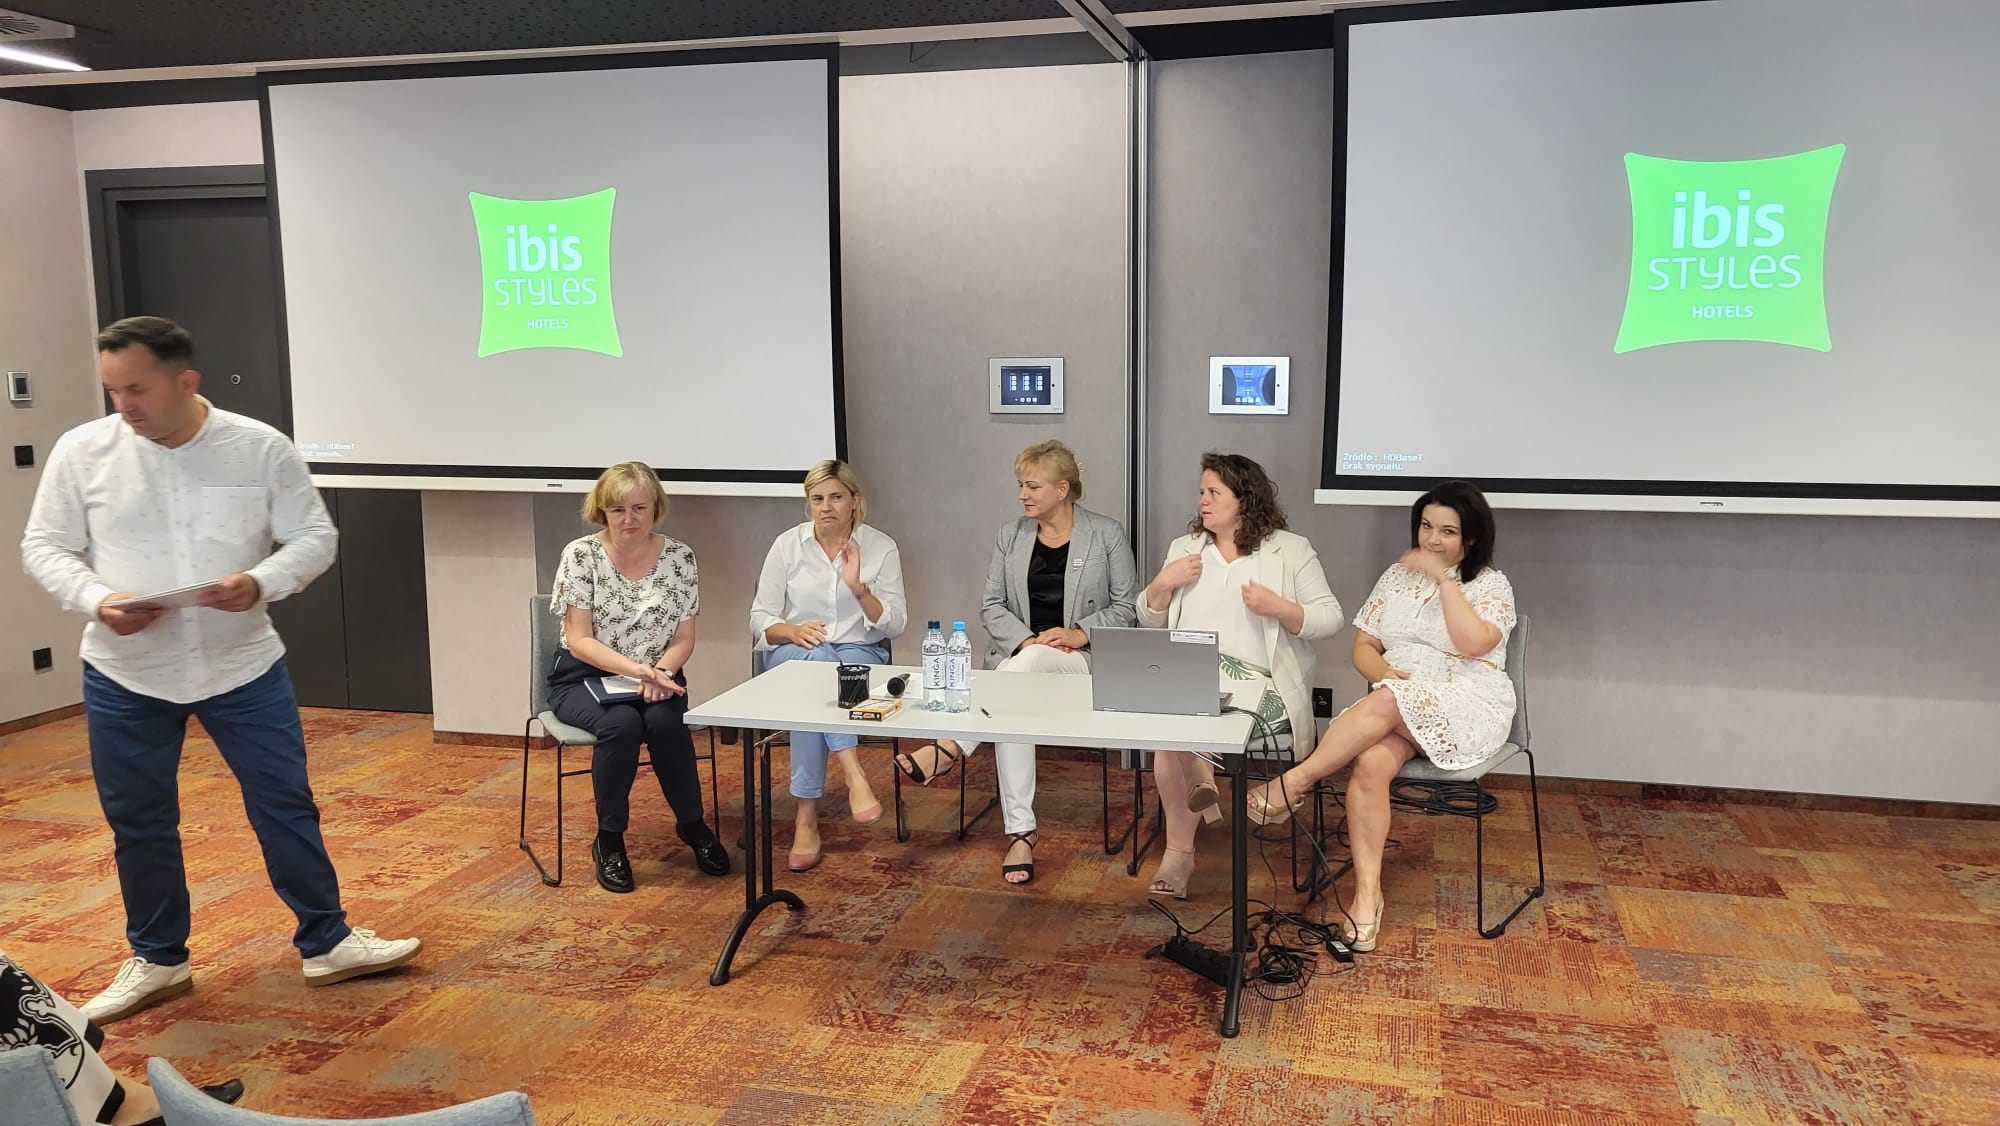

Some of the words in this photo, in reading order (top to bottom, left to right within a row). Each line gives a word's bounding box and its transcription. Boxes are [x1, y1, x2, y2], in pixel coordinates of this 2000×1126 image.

[1672, 189, 1785, 249] ibis
[505, 223, 583, 273] ibis
[527, 318, 569, 330] HOTELS
[1691, 305, 1754, 319] HOTELS
[933, 657, 941, 687] KINGA
